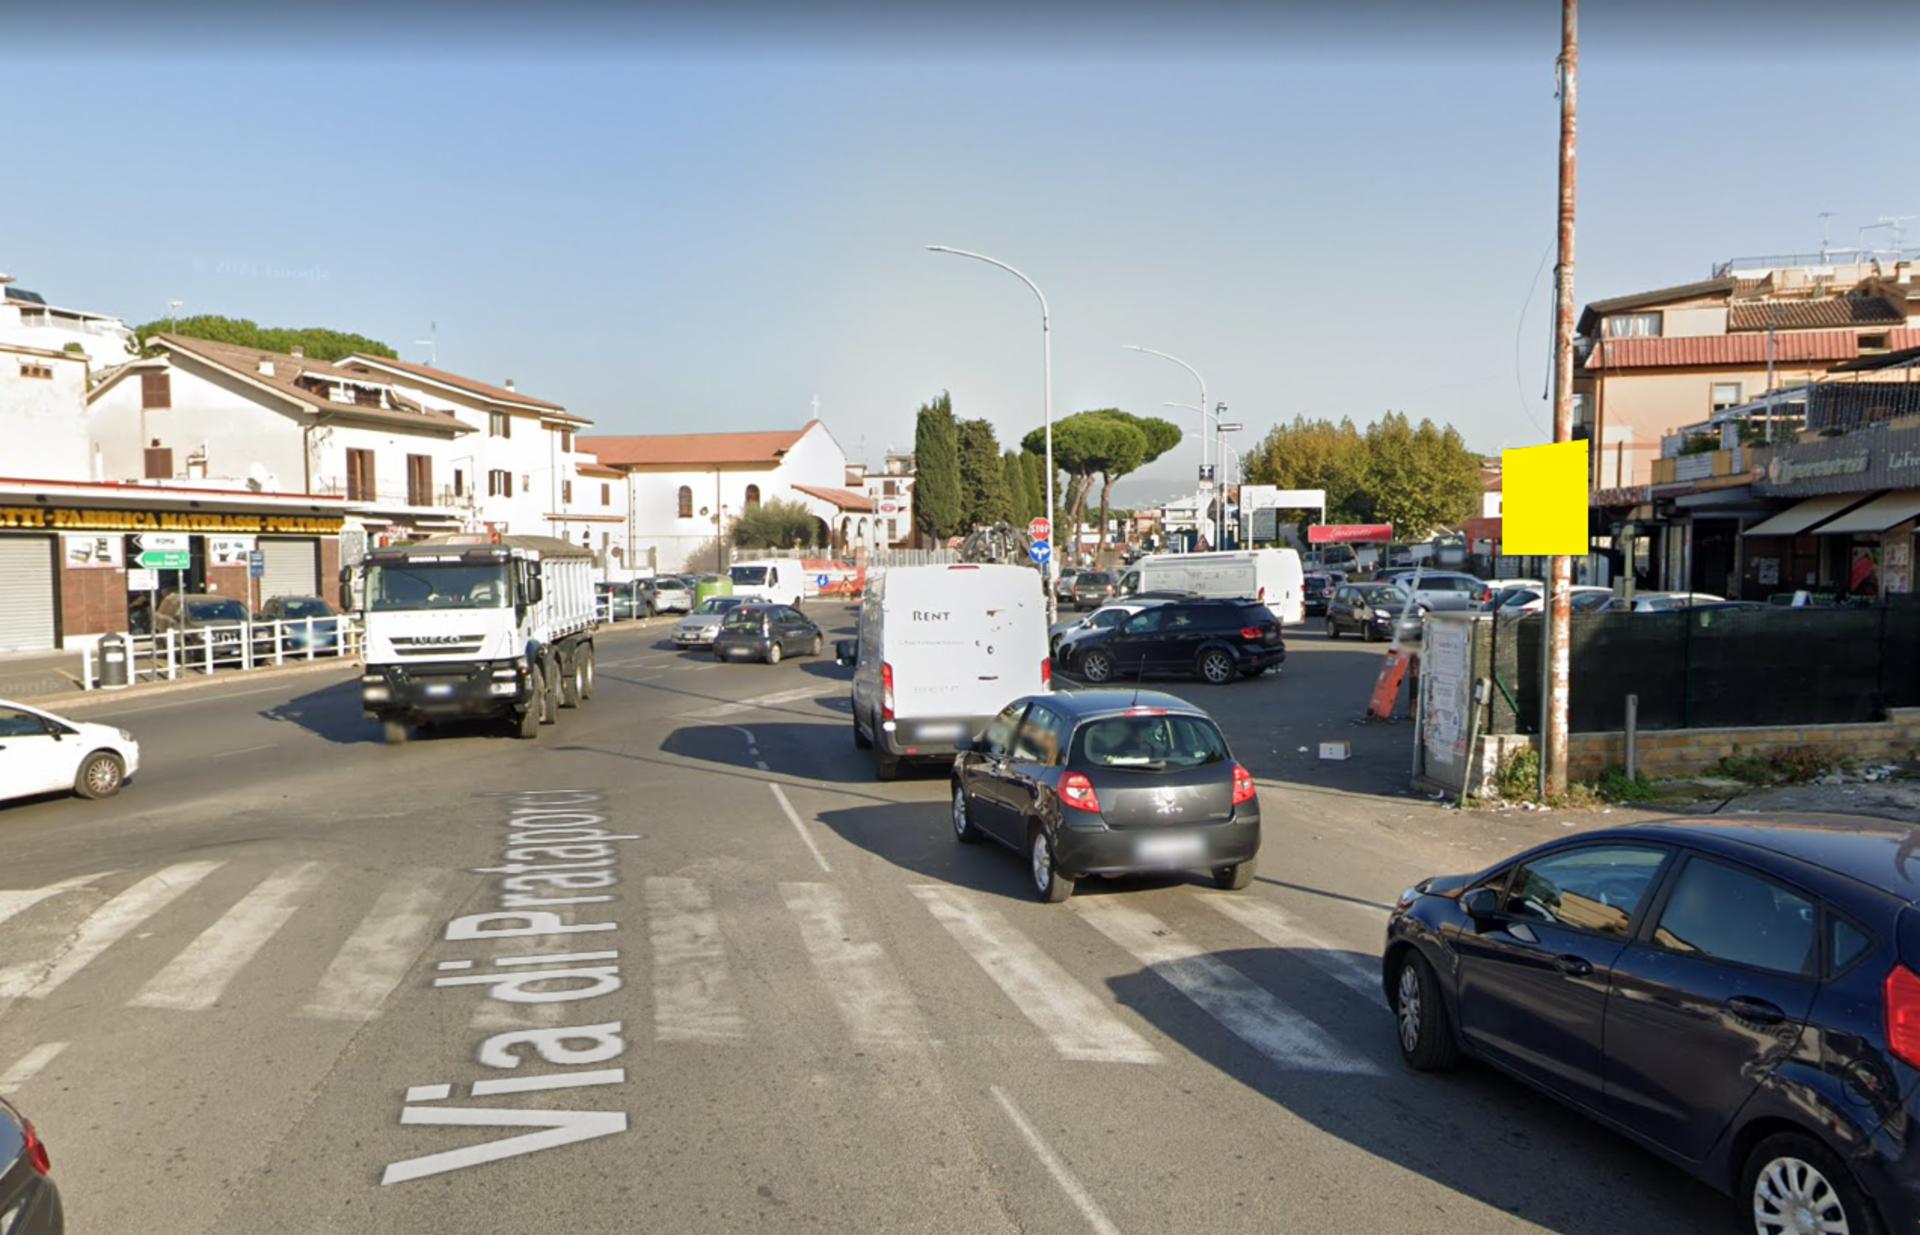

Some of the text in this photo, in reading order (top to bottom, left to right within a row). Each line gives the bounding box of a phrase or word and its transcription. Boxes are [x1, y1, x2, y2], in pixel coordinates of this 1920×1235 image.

[53, 509, 159, 529] FABBRICA
[161, 512, 261, 531] MATERASSI
[1030, 524, 1050, 535] STOP
[912, 610, 951, 622] RENT
[411, 635, 460, 646] IVECO
